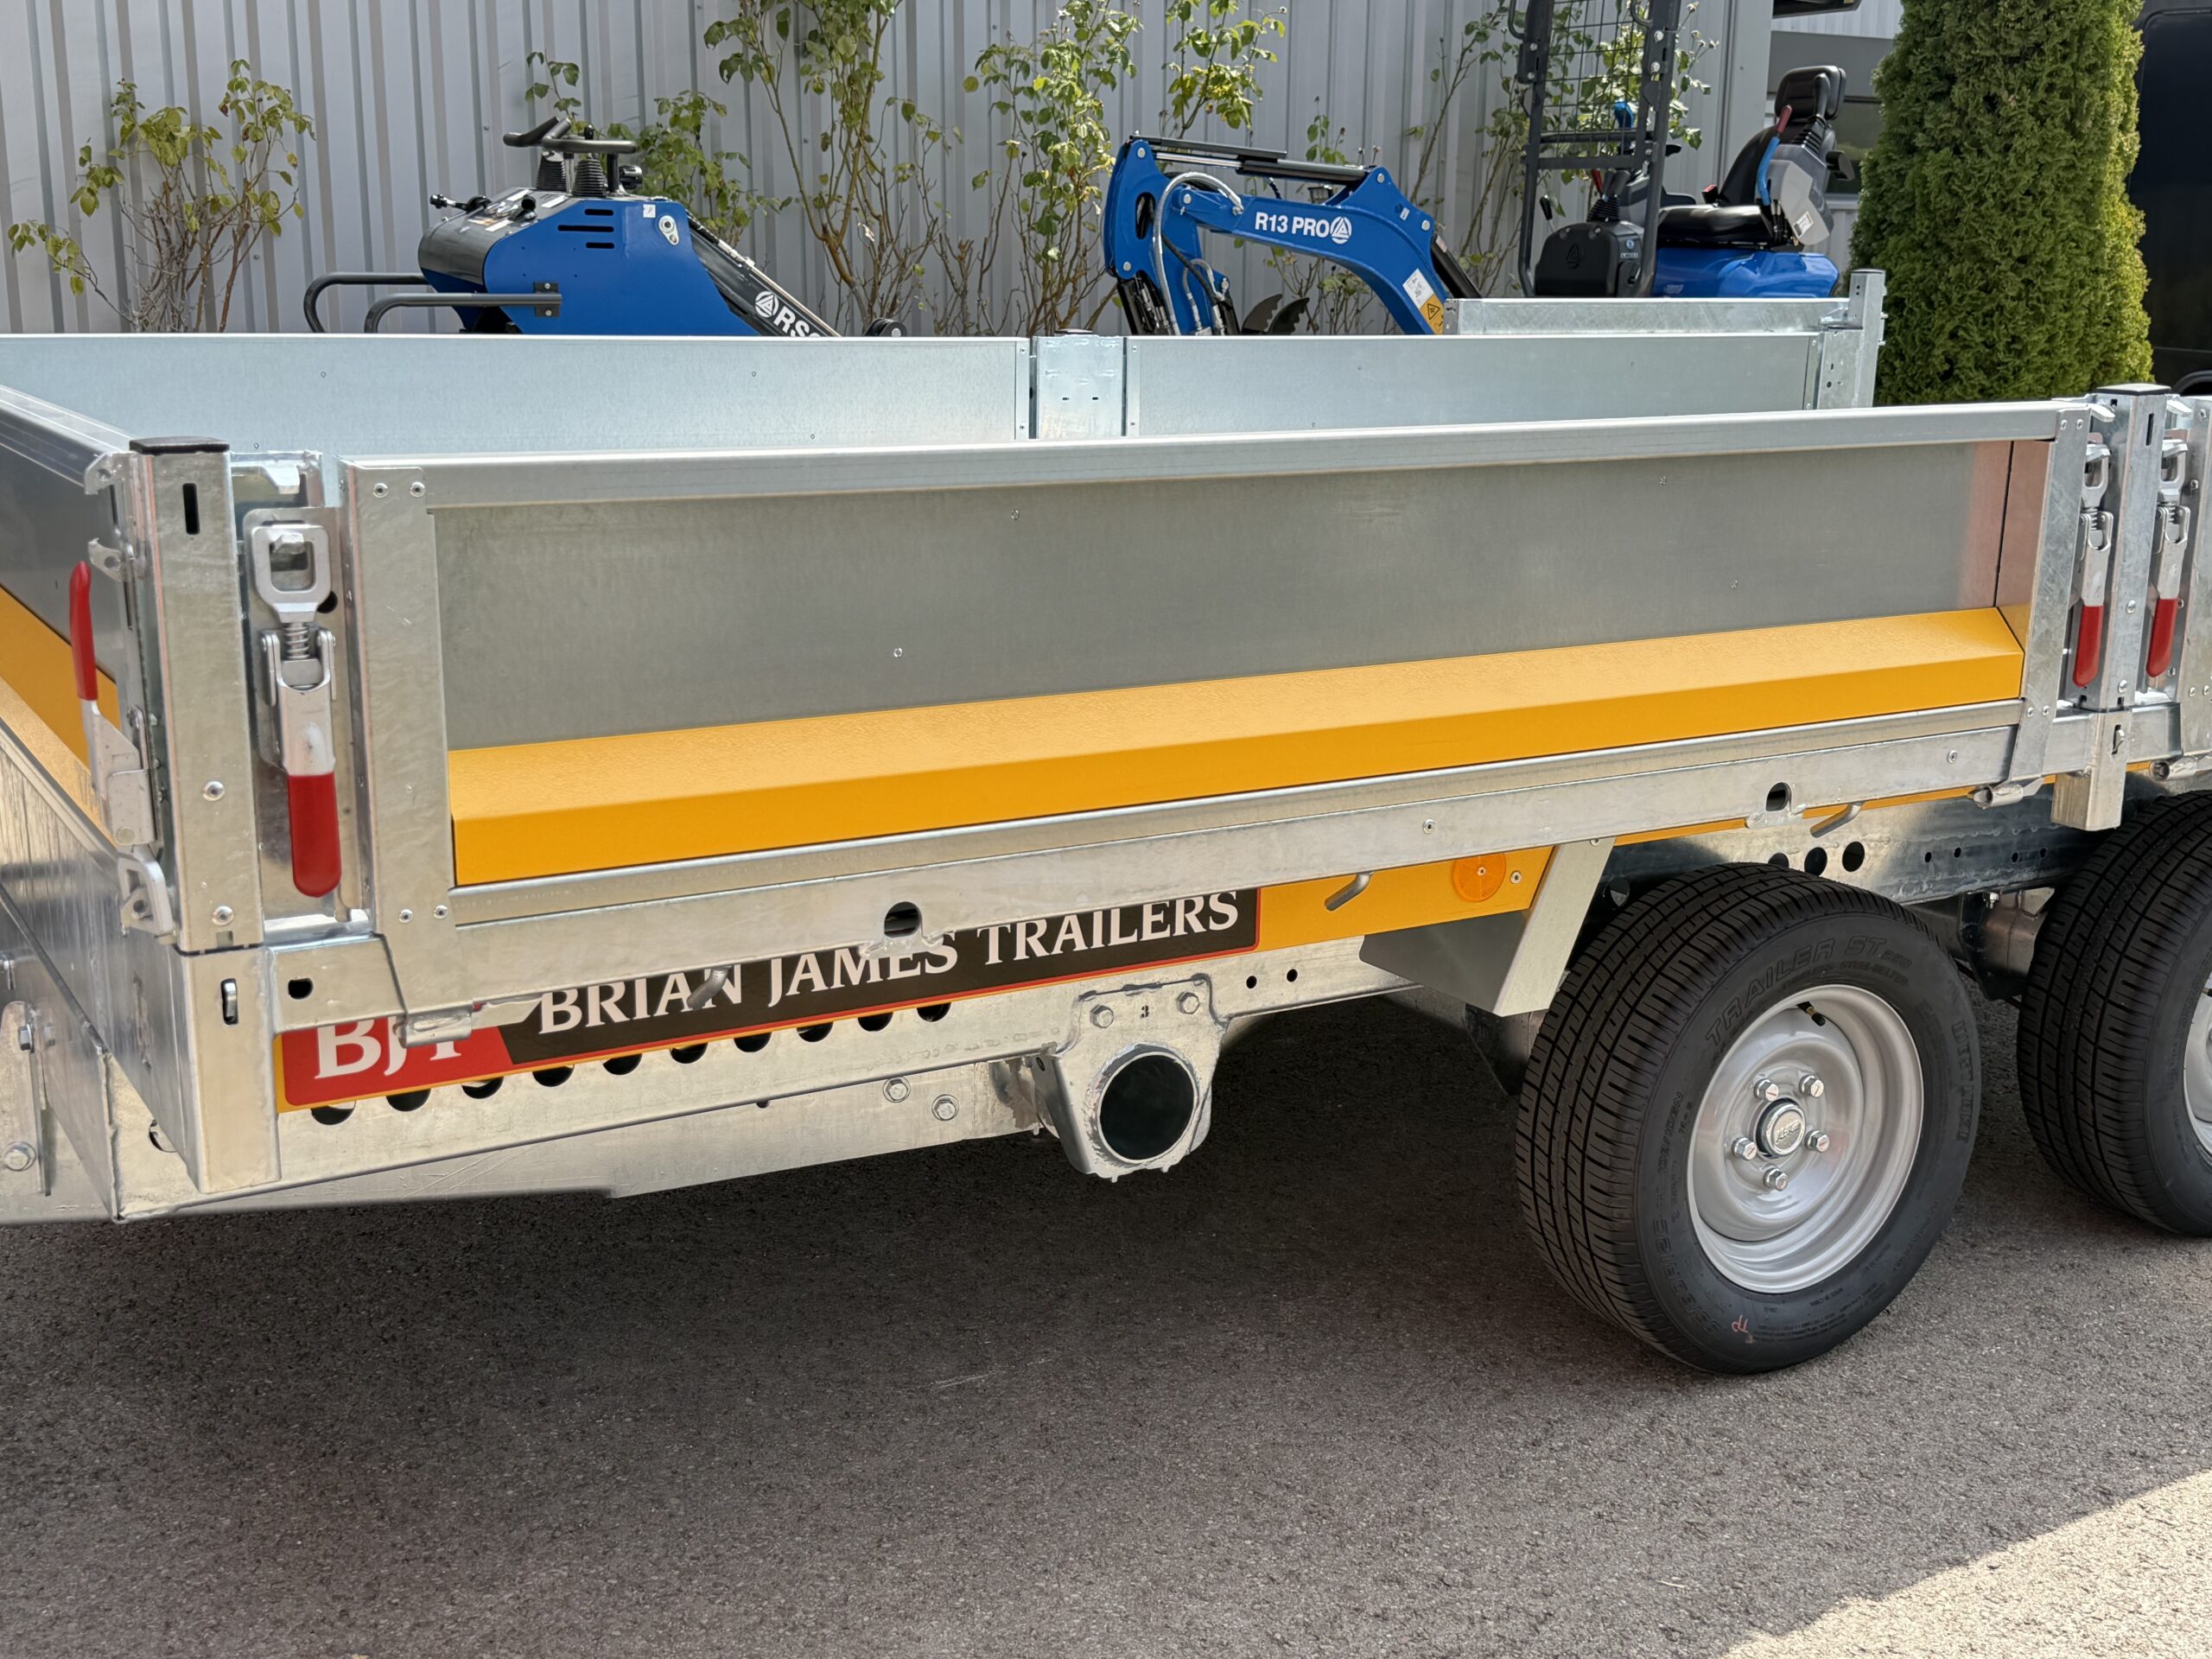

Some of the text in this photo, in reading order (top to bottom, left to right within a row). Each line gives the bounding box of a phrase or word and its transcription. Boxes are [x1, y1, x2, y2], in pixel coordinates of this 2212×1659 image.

[1255, 212, 1330, 238] R13 PRO
[773, 305, 821, 336] RS
[538, 891, 1239, 1034] BRIAN JAMES TRAILERS
[1141, 1005, 1149, 1018] 3
[1706, 938, 1835, 1046] TRAILER
[314, 1015, 461, 1079] BJ
